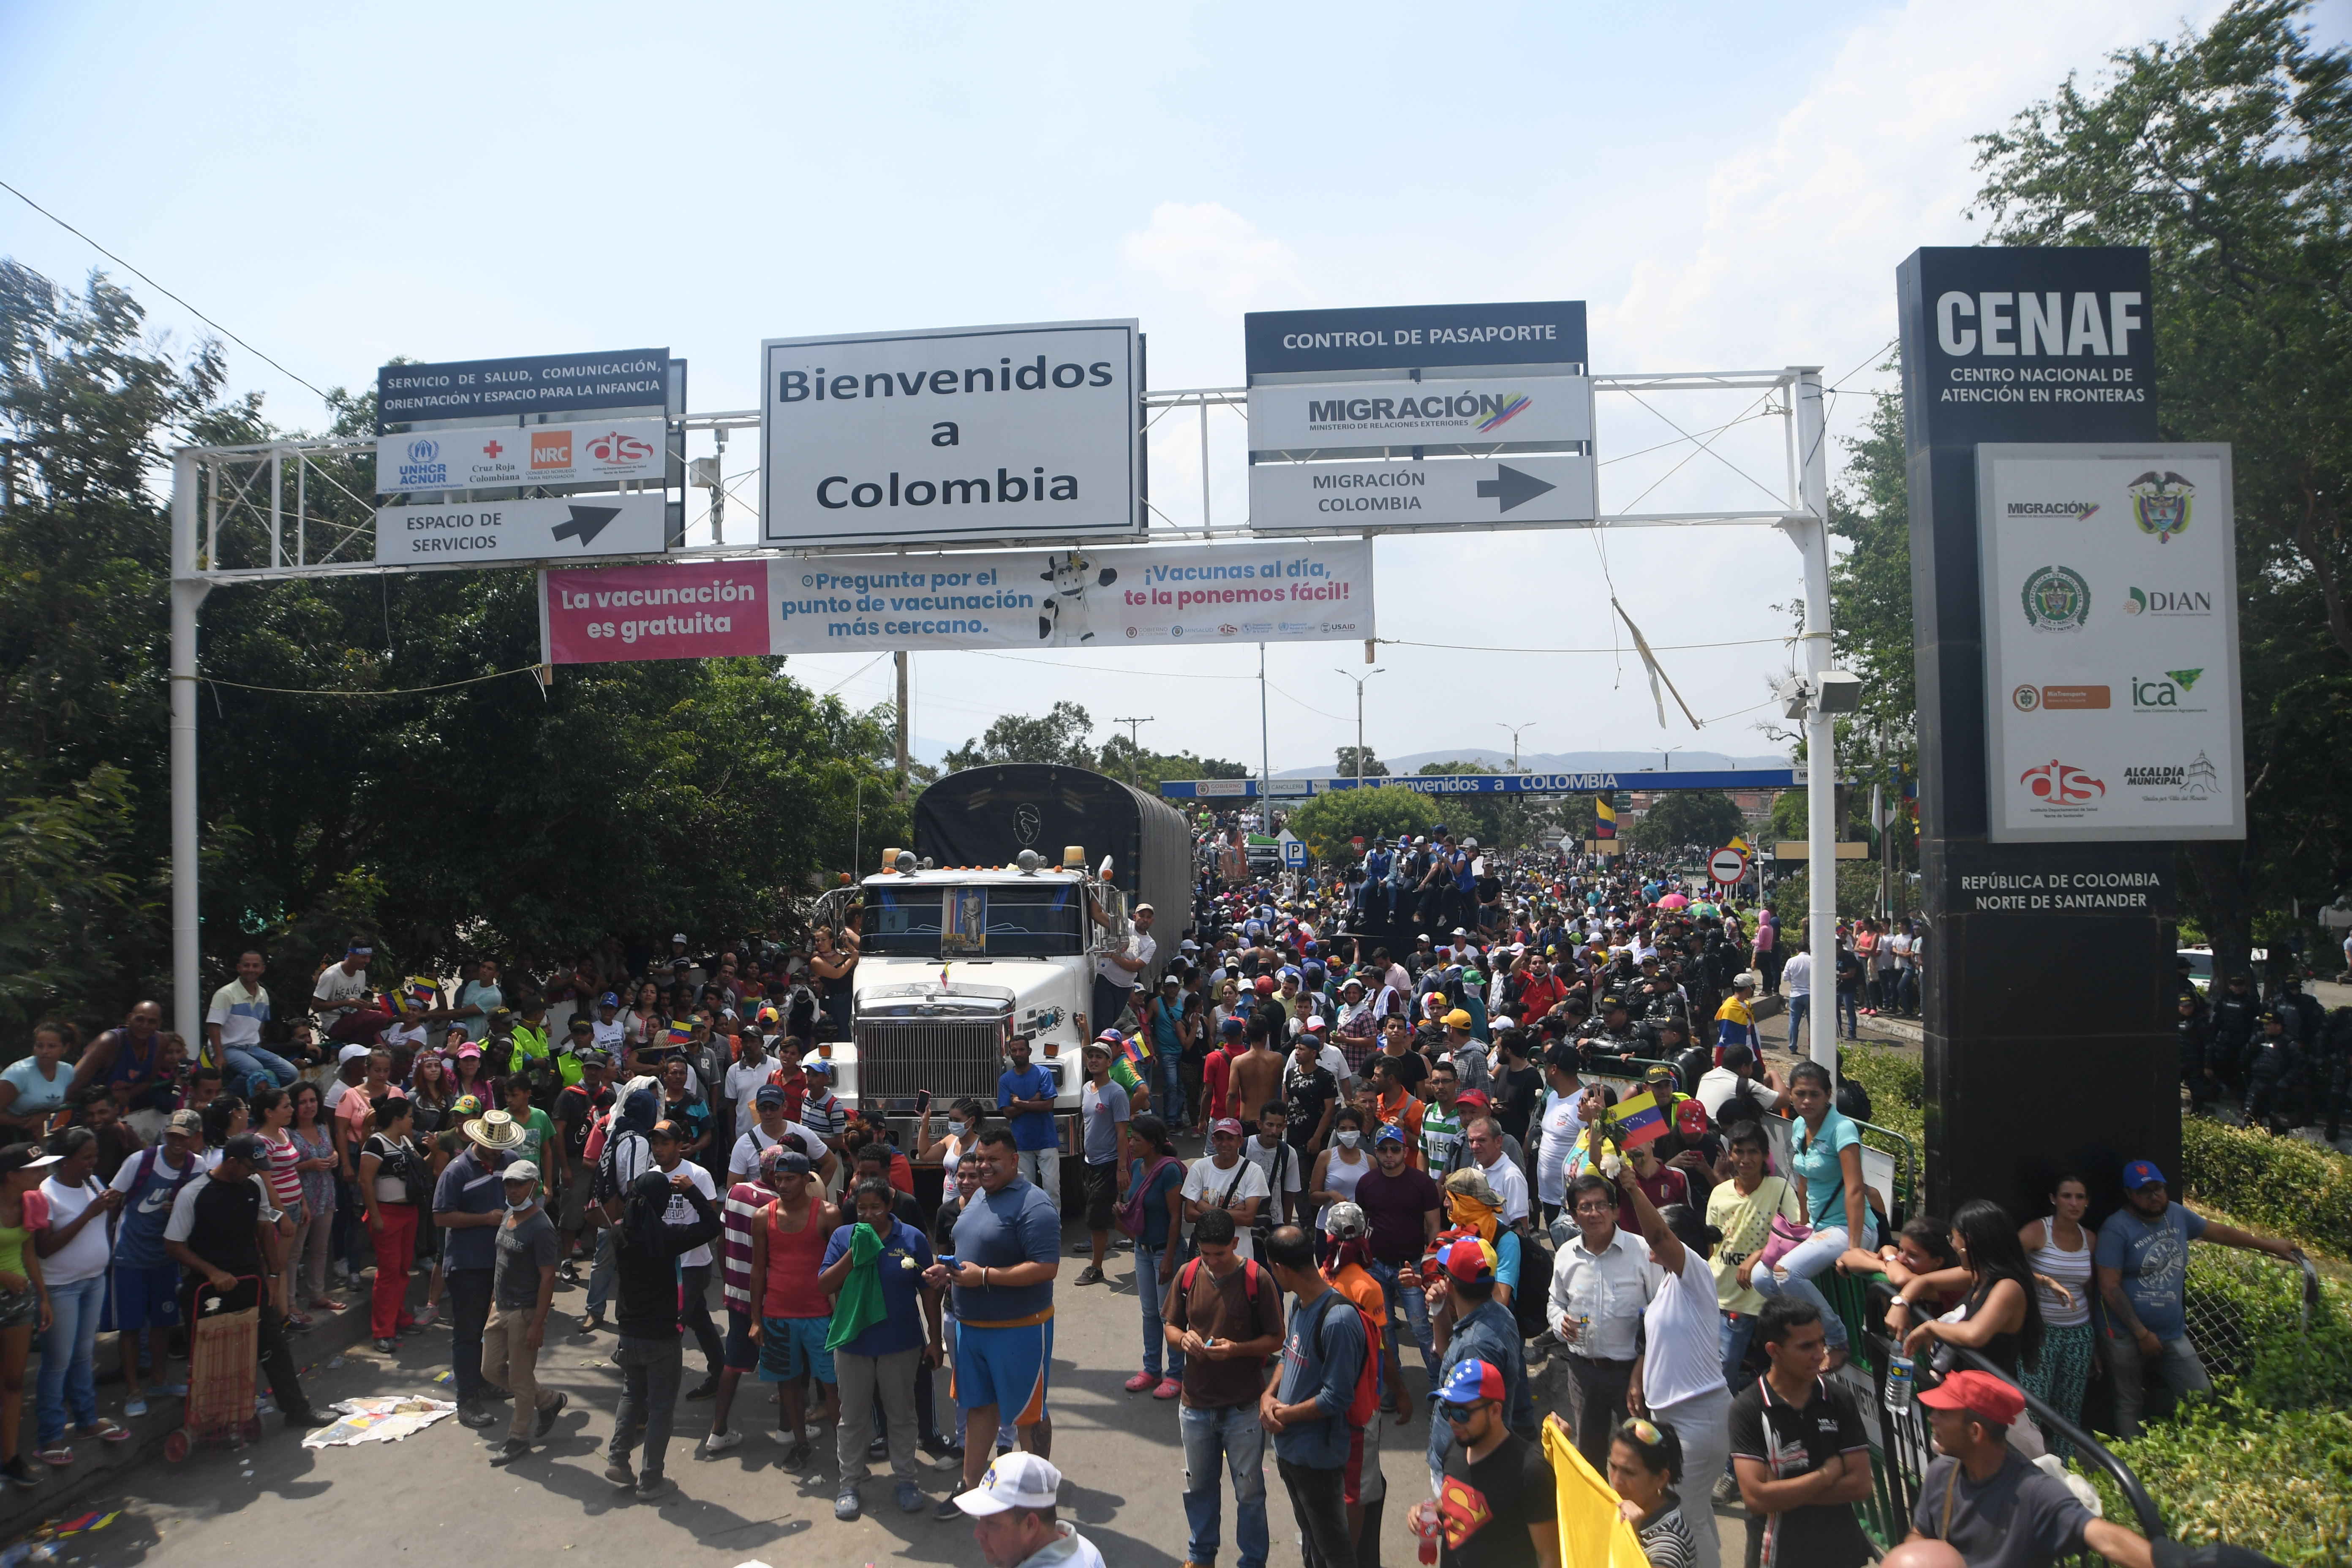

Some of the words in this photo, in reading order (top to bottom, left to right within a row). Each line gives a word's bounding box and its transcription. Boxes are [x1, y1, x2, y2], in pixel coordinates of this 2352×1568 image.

[1937, 291, 2141, 356] CENAF
[1283, 331, 1387, 349] CONTROL
[1395, 329, 1421, 344] DE
[1430, 324, 1556, 344] PASAPORTE
[387, 376, 449, 389] SERVICIO
[459, 374, 475, 384] DE
[485, 370, 532, 383] SALUD,
[542, 359, 661, 379] COMUNICACIÓN,
[780, 355, 1113, 402] Bienvenidos
[1950, 368, 2014, 381] CENTRO
[2020, 368, 2107, 381] NACIONAL
[2113, 368, 2132, 381] DE
[384, 391, 469, 410] ORIENTACIÓN
[473, 393, 481, 403] Y
[485, 389, 536, 402] ESPACIO
[540, 387, 573, 398] PARA
[577, 385, 592, 395] LA
[597, 380, 659, 394] INFANCIA
[1941, 385, 2024, 402] ATENCIÓN
[2030, 389, 2051, 402] EN
[2055, 388, 2144, 402] FRONTERAS
[1309, 390, 1504, 422] MIGRACIÓN
[931, 422, 959, 446] a
[534, 446, 568, 463] NRC
[399, 463, 446, 475] UNHCR
[495, 463, 515, 472] Roja
[400, 474, 446, 485] ACNUR
[469, 473, 520, 482] Colombiana
[1313, 470, 1424, 489] MIGRACIÓN
[817, 467, 1078, 509] Colombia
[1318, 496, 1421, 512] COLOMBIA
[2008, 501, 2088, 514] MIGRACIÓN
[407, 514, 474, 530] ESPACIO
[481, 512, 502, 526] DE
[413, 535, 496, 552] SERVICIOS
[1145, 564, 1255, 585] ¡Vacunas
[1260, 560, 1281, 578] al
[1287, 558, 1331, 579] día,
[816, 571, 925, 594] Pregunta
[931, 571, 971, 592] por
[977, 568, 997, 585] el
[562, 590, 589, 609] La
[595, 579, 754, 607] vacunación
[1124, 589, 1146, 606] te
[1152, 588, 1172, 604] la
[1178, 583, 1285, 610] ponemos
[1290, 582, 1349, 601] fácil!
[2150, 592, 2210, 610] DIAN
[782, 596, 851, 620] punto
[856, 594, 885, 612] de
[890, 589, 1033, 612] vacunación
[587, 621, 615, 638] es
[621, 612, 730, 643] gratuita
[828, 617, 879, 636] más
[885, 618, 989, 634] cercano.
[2132, 677, 2177, 706] ica
[2123, 765, 2184, 776] ALCALDÍA
[1494, 780, 1504, 790] a
[1520, 774, 1618, 790] COLOMBIA
[2127, 777, 2182, 785] MUNICIPAL
[1292, 845, 1299, 858] P
[1962, 872, 2044, 889] REPÚBLICA
[2049, 874, 2068, 888] DE
[2073, 873, 2160, 887] COLOMBIA
[1976, 896, 2026, 910] NORTE
[2031, 895, 2050, 909] DE
[2055, 893, 2147, 908] SANTANDER
[701, 1058, 710, 1070] 82
[504, 1236, 524, 1250] YORK
